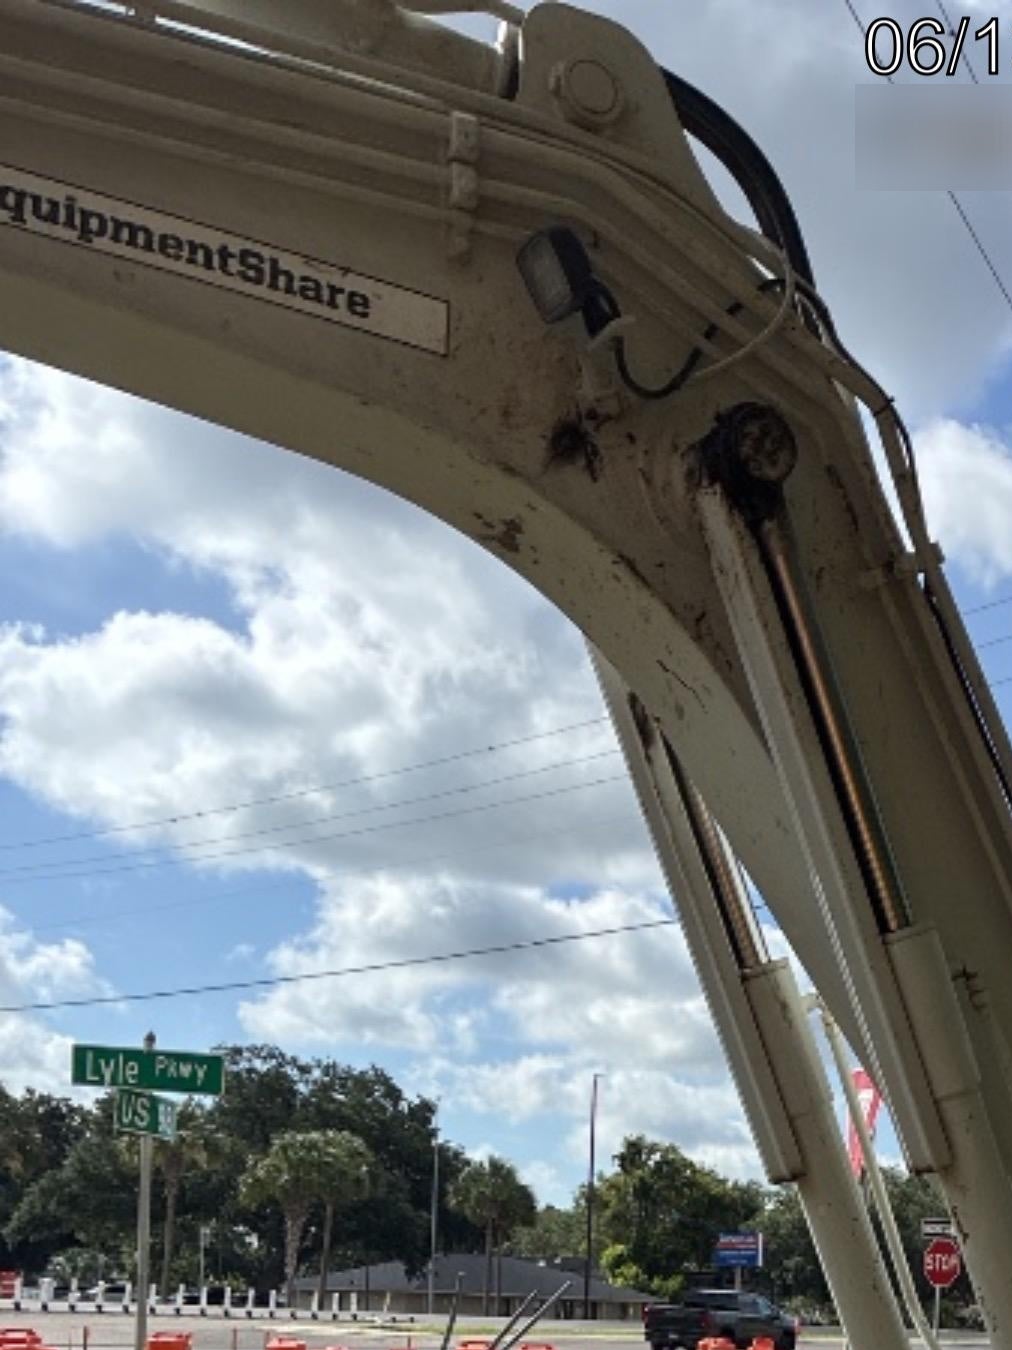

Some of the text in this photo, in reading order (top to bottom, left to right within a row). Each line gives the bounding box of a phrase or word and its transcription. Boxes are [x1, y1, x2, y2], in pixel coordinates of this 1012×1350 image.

[86, 1050, 207, 1087] Lyle Pkwy
[121, 1093, 150, 1128] US
